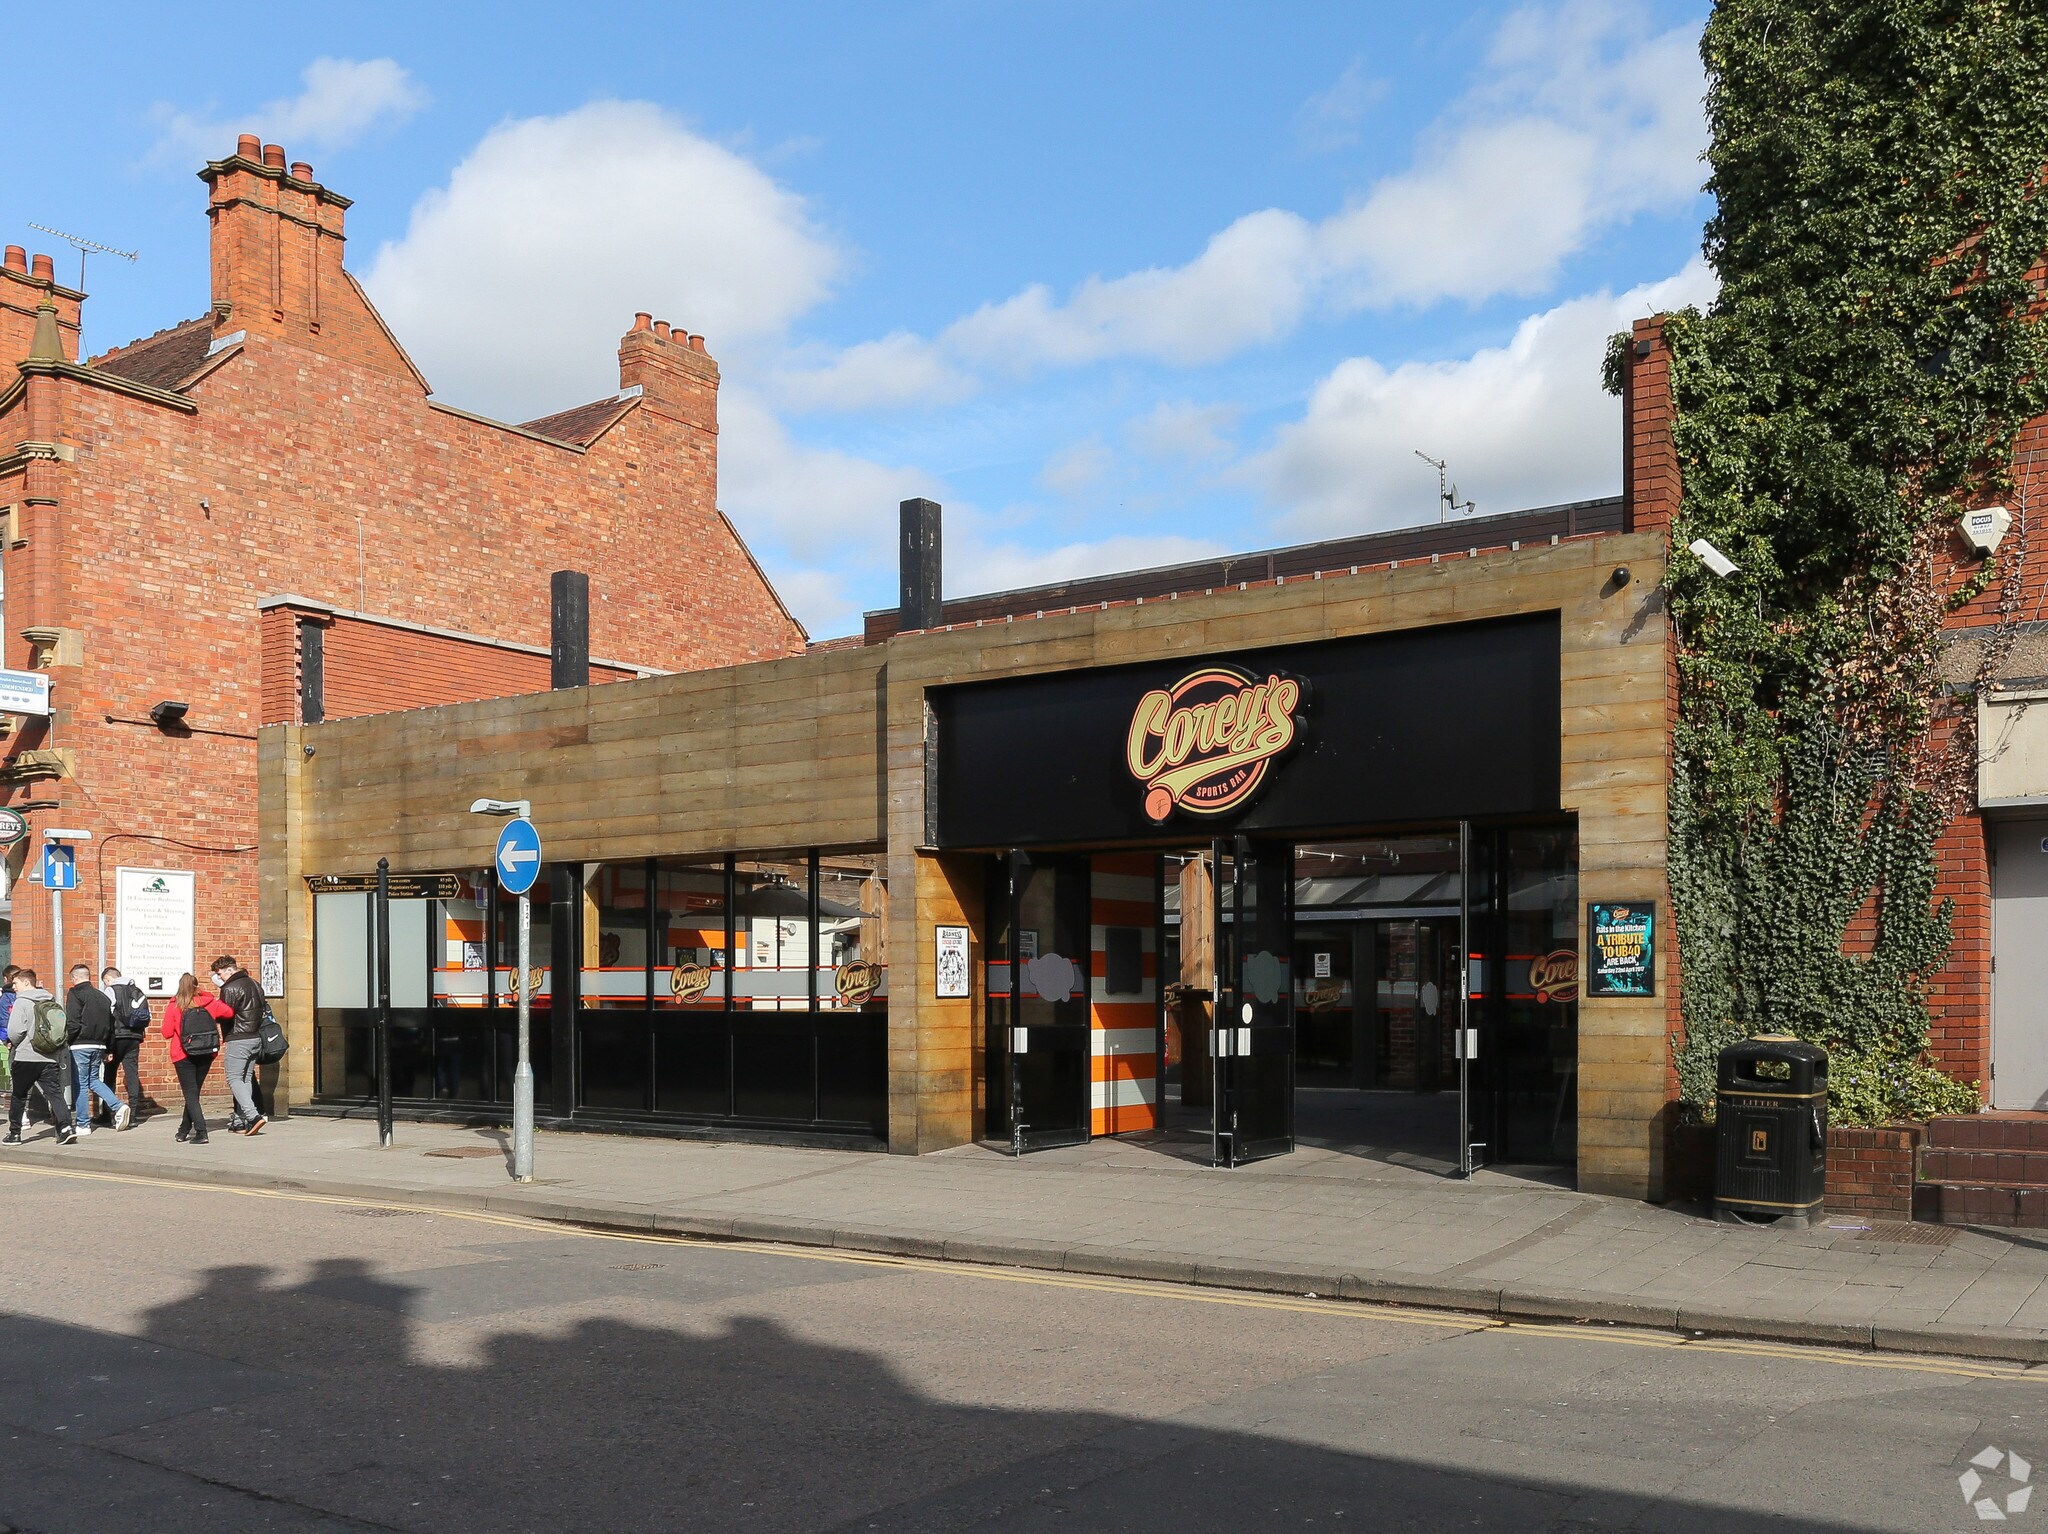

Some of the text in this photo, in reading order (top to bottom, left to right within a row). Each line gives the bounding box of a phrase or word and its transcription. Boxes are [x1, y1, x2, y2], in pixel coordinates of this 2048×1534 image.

[1972, 516, 1992, 524] FOCUS
[1128, 675, 1298, 779] Corey's
[1196, 769, 1248, 798] SPORTS BAR
[1615, 925, 1625, 933] the
[1625, 924, 1646, 932] Kitchen
[1597, 933, 1645, 946] A TRIBUTE
[1602, 945, 1641, 958] TO UB40
[1606, 956, 1637, 966] ARE BACK
[671, 966, 711, 993] Corey's
[836, 963, 882, 993] Corey's
[1743, 1099, 1779, 1107] LITTER
